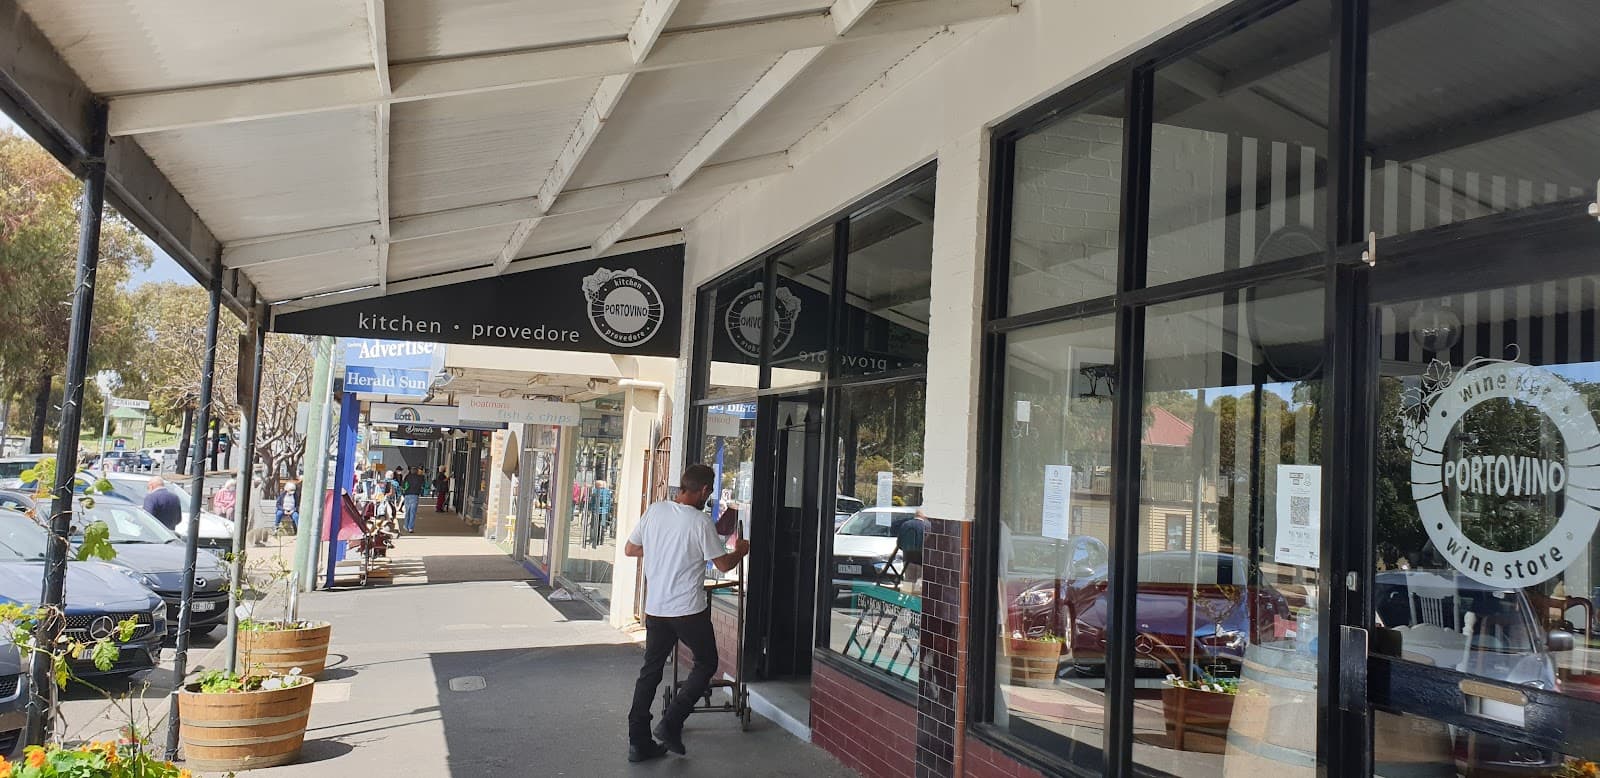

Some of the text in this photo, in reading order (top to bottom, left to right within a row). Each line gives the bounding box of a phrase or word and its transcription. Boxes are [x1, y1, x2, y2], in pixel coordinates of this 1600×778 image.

[613, 279, 642, 290] kitchen
[605, 304, 648, 317] PORTOVINO
[358, 312, 580, 344] kitchen provedore
[605, 329, 645, 341] provedore
[346, 372, 426, 390] Herald Sun
[1458, 373, 1507, 403] wine
[1444, 454, 1566, 497] PORTOVINO
[1446, 537, 1563, 580] wine store
